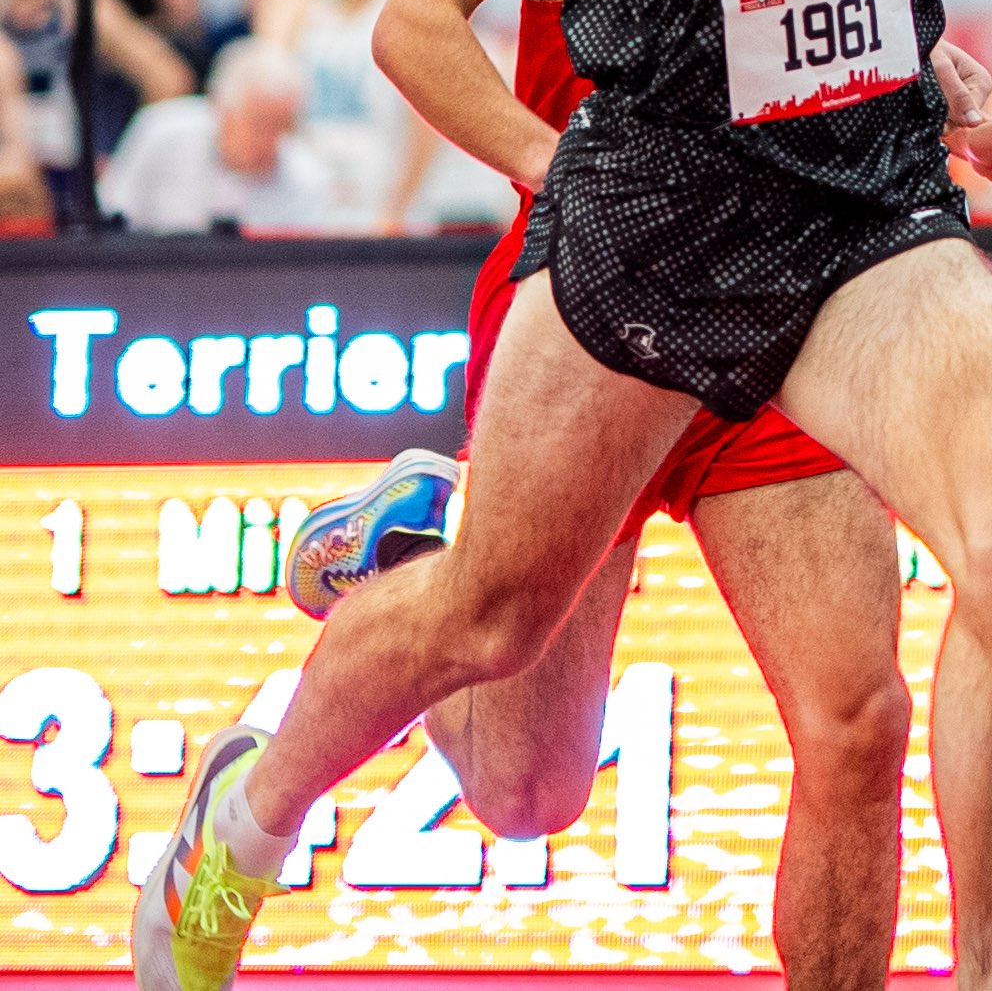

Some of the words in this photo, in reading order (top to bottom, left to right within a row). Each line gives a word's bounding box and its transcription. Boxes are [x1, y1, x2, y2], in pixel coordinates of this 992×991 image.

[28, 304, 470, 418] Terrier
[40, 497, 84, 595] 1
[157, 496, 312, 596] Mil
